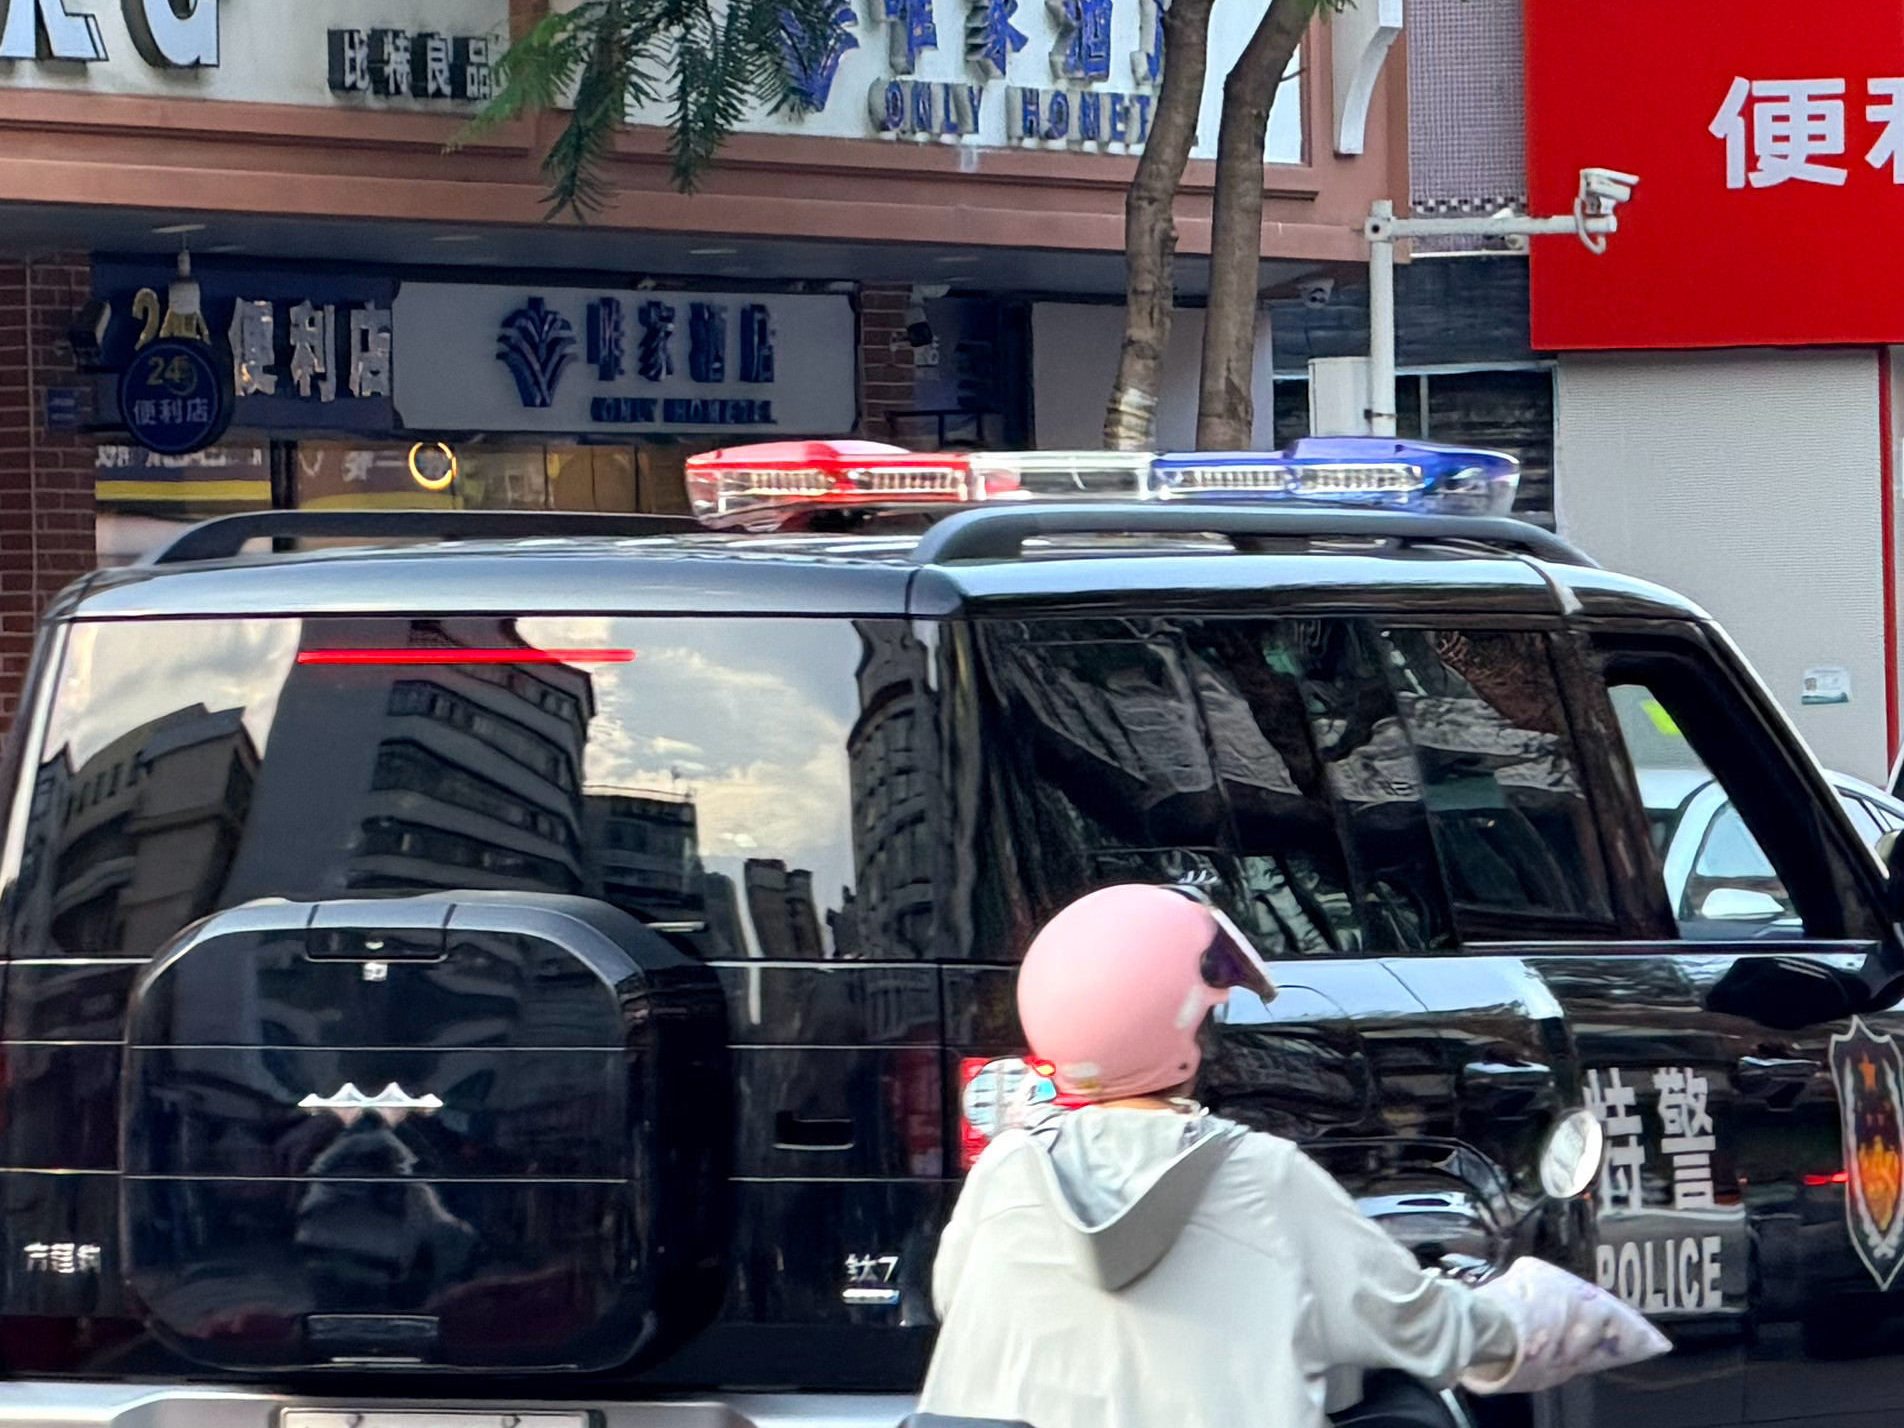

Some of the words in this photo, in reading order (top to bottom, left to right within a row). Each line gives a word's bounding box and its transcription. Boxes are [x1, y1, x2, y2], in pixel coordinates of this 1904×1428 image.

[132, 398, 210, 426] 便利店
[1598, 1235, 1723, 1310] POLICE
